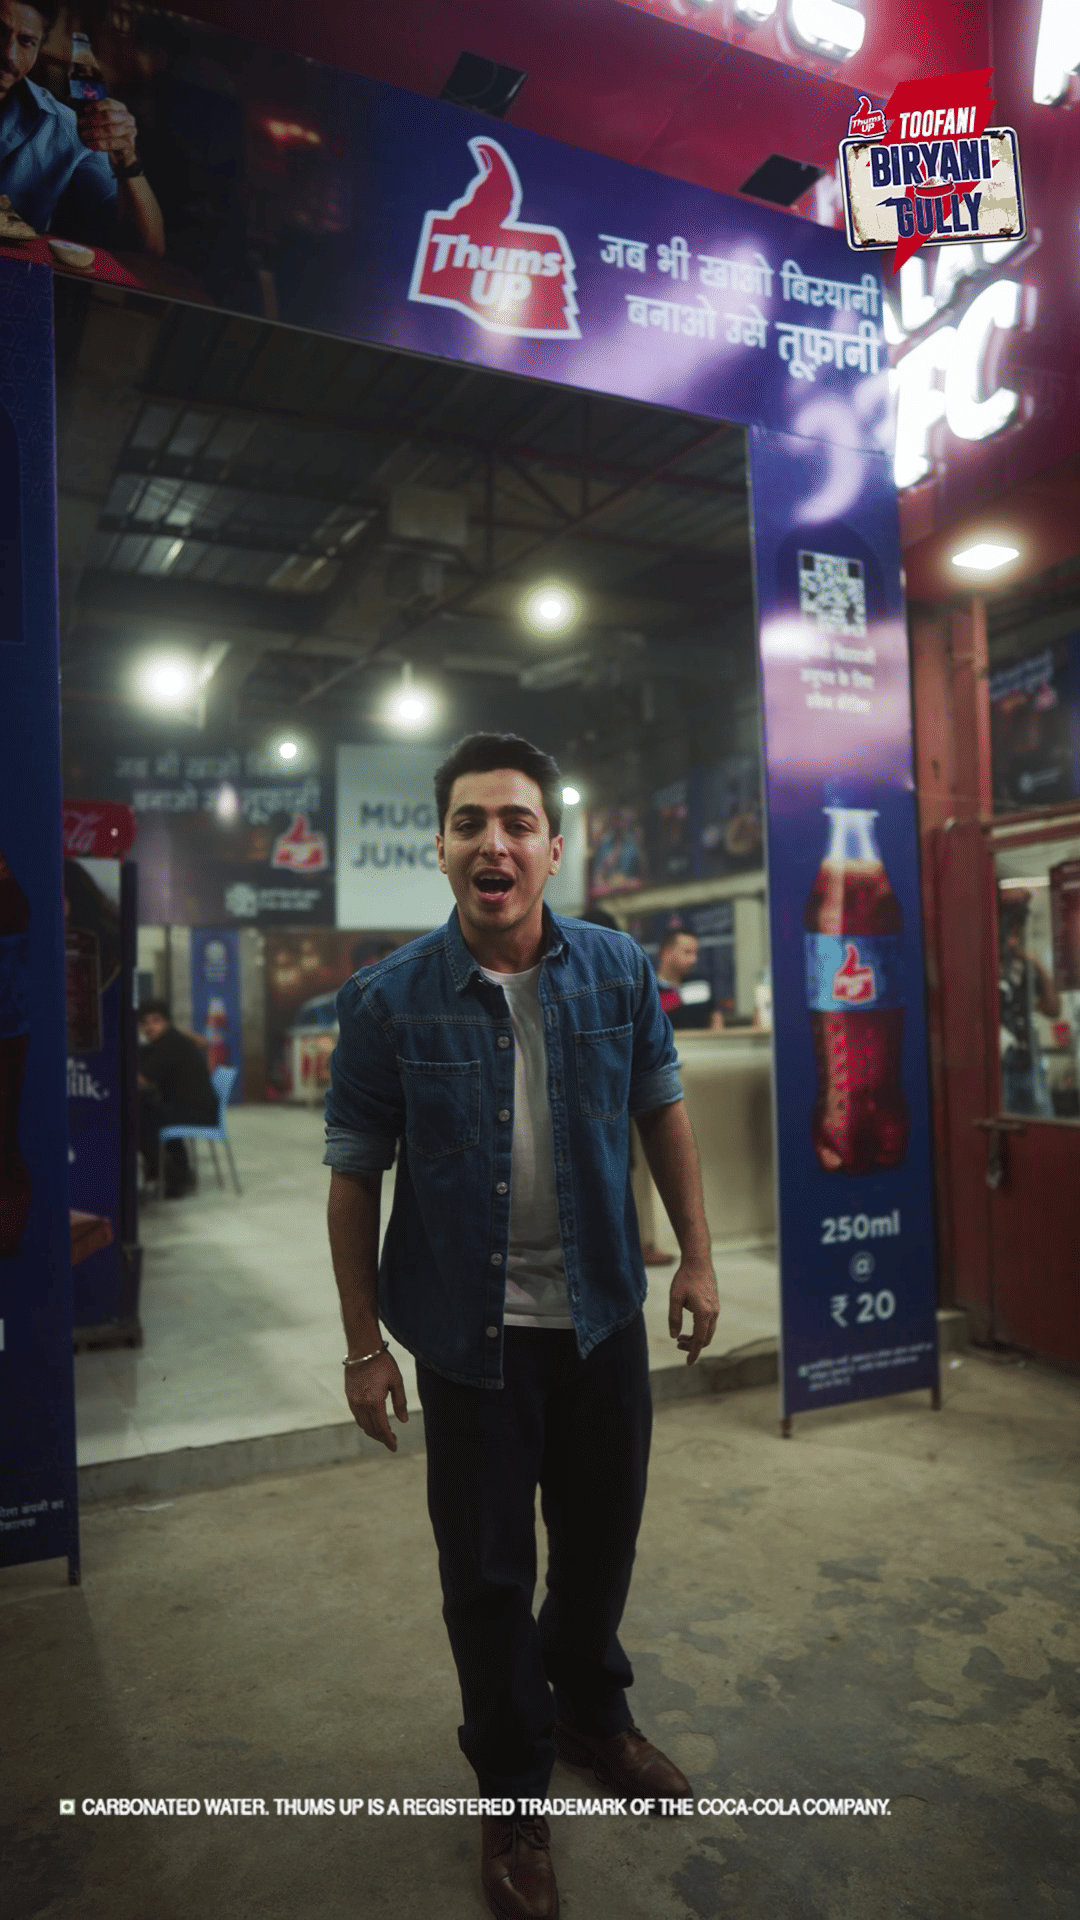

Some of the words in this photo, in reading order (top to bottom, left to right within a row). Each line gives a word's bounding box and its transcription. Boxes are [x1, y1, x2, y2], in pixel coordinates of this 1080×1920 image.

[431, 234, 563, 277] Thums
[598, 234, 649, 272] जब
[657, 236, 691, 281] भी
[697, 252, 775, 298] खाओ
[779, 259, 880, 317] बिरयानी
[625, 294, 717, 340] बनाओ
[725, 303, 768, 349] उसे
[820, 1208, 901, 1245] 250ml
[856, 1289, 897, 1324] 20
